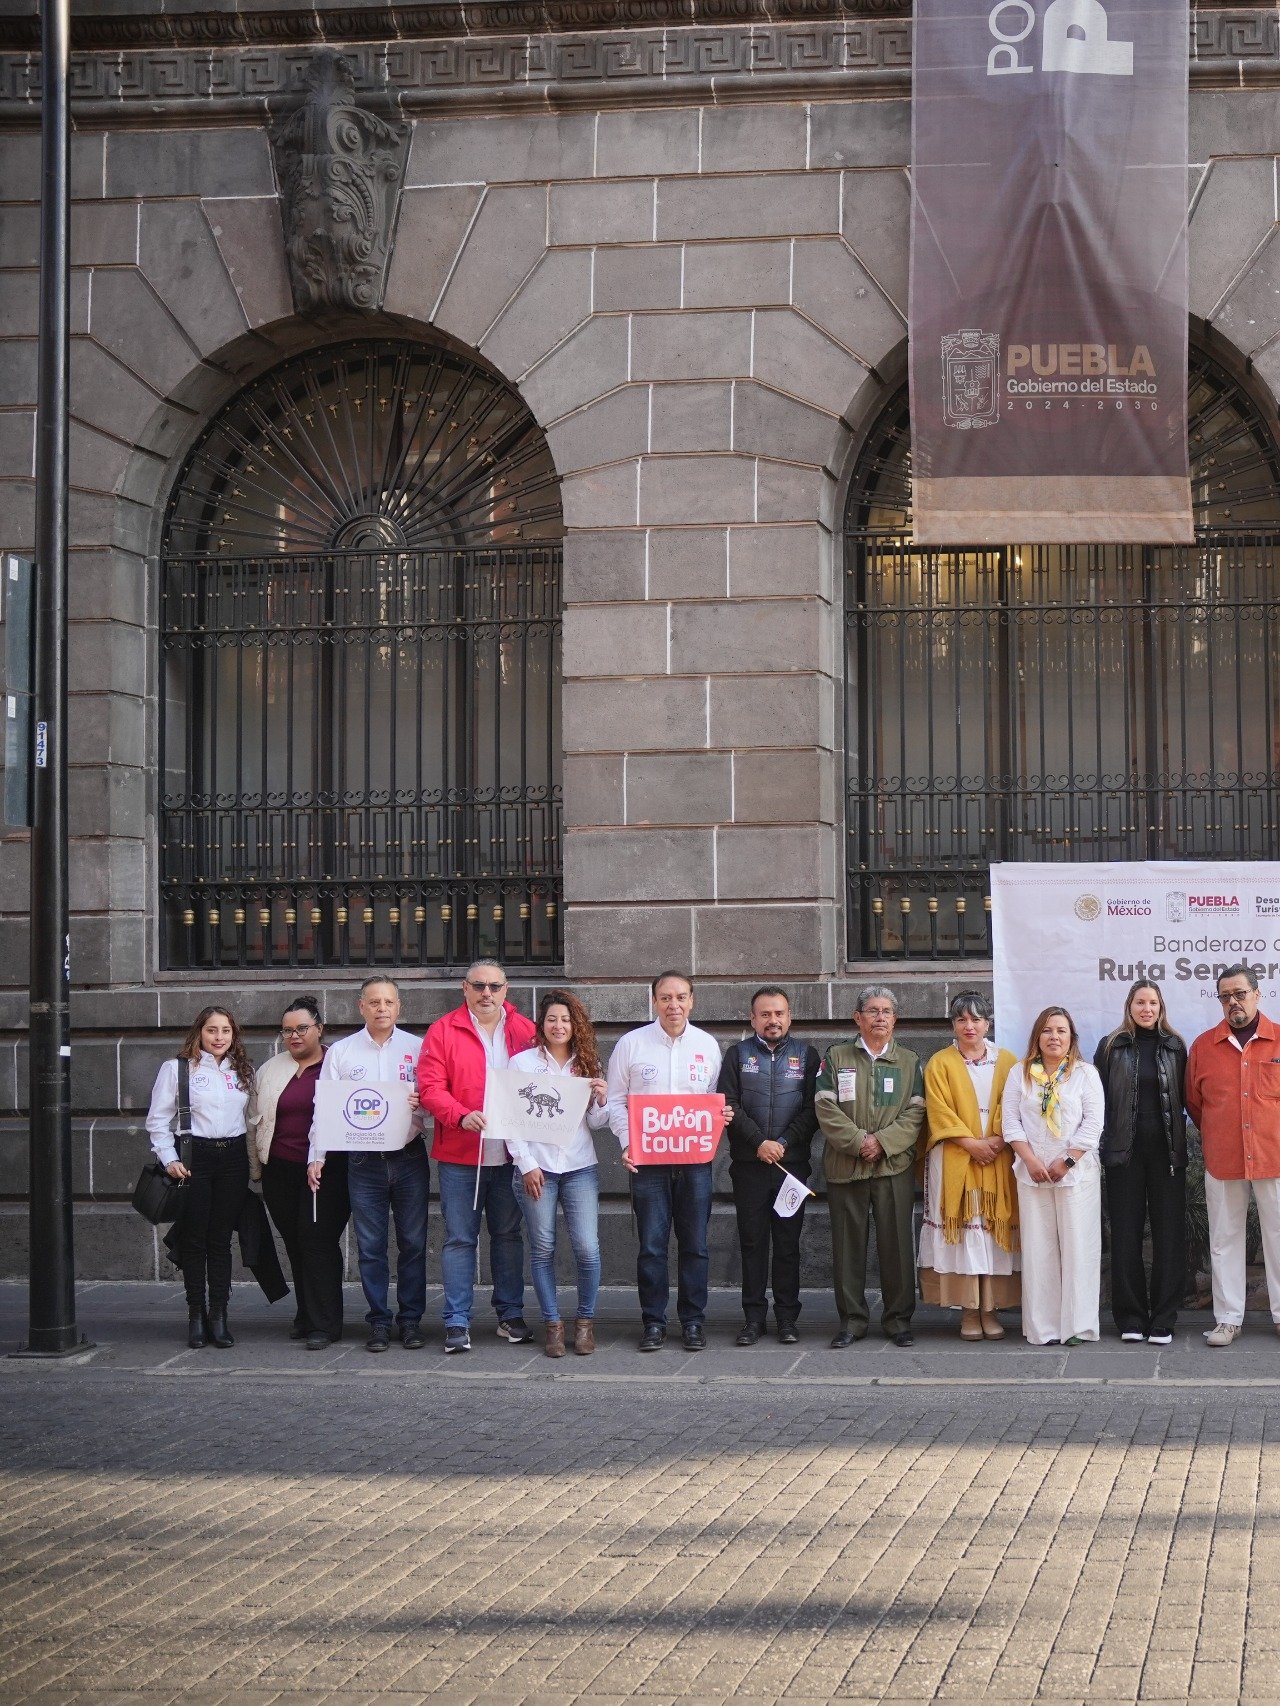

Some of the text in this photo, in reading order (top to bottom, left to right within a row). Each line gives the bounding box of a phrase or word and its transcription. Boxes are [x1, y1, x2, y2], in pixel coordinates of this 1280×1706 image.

[1006, 343, 1157, 376] PUEBLA
[1006, 378, 1158, 394] Gobierno del Estado
[36, 723, 46, 765] 91473
[1107, 904, 1152, 916] México
[1188, 896, 1240, 906] PUEBLA
[1153, 935, 1267, 953] Banderazo
[1098, 957, 1166, 982] Ruta
[353, 1098, 381, 1111] TOP
[642, 1105, 713, 1134] Bufón
[641, 1132, 713, 1153] tours
